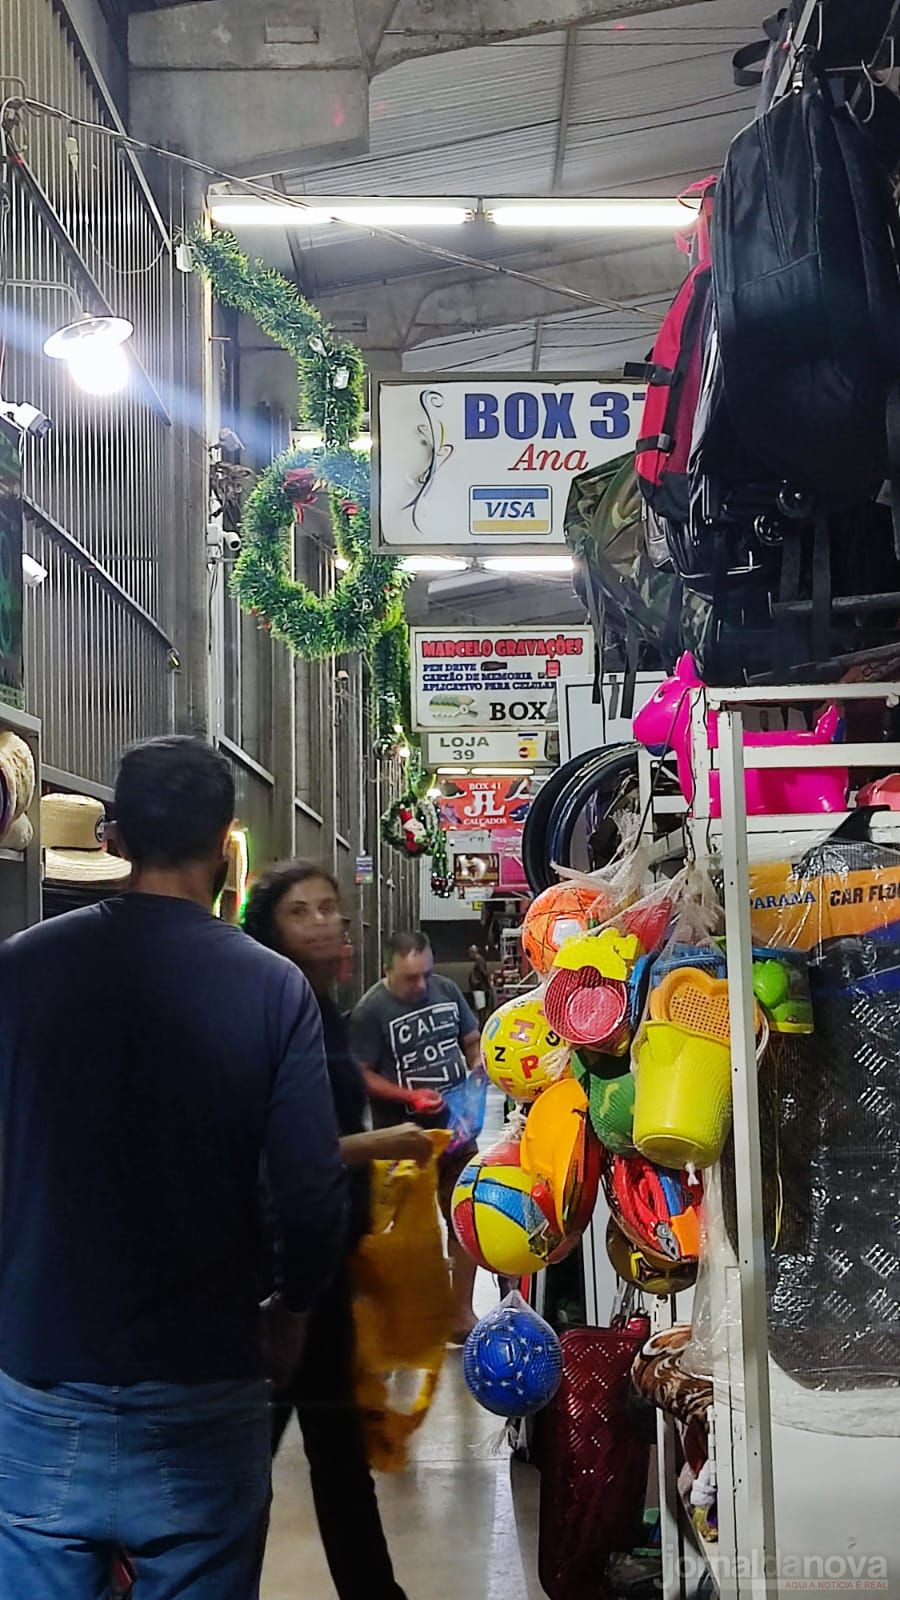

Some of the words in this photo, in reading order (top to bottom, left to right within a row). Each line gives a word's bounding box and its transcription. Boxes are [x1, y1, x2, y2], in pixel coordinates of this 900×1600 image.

[464, 392, 577, 440] BOX
[590, 391, 646, 440] 3
[507, 443, 589, 471] Ana
[485, 501, 536, 518] VISA
[422, 639, 493, 658] MARCELO
[495, 634, 583, 658] GRAVAÇÕES
[422, 672, 464, 681] CARTÃO
[465, 673, 479, 681] DE
[423, 664, 443, 672] PEN
[489, 702, 547, 721] BOX
[440, 737, 489, 748] LOJA
[453, 750, 475, 761] 39
[464, 790, 506, 816] JL
[829, 888, 863, 906] CAR
[520, 1055, 539, 1079] P
